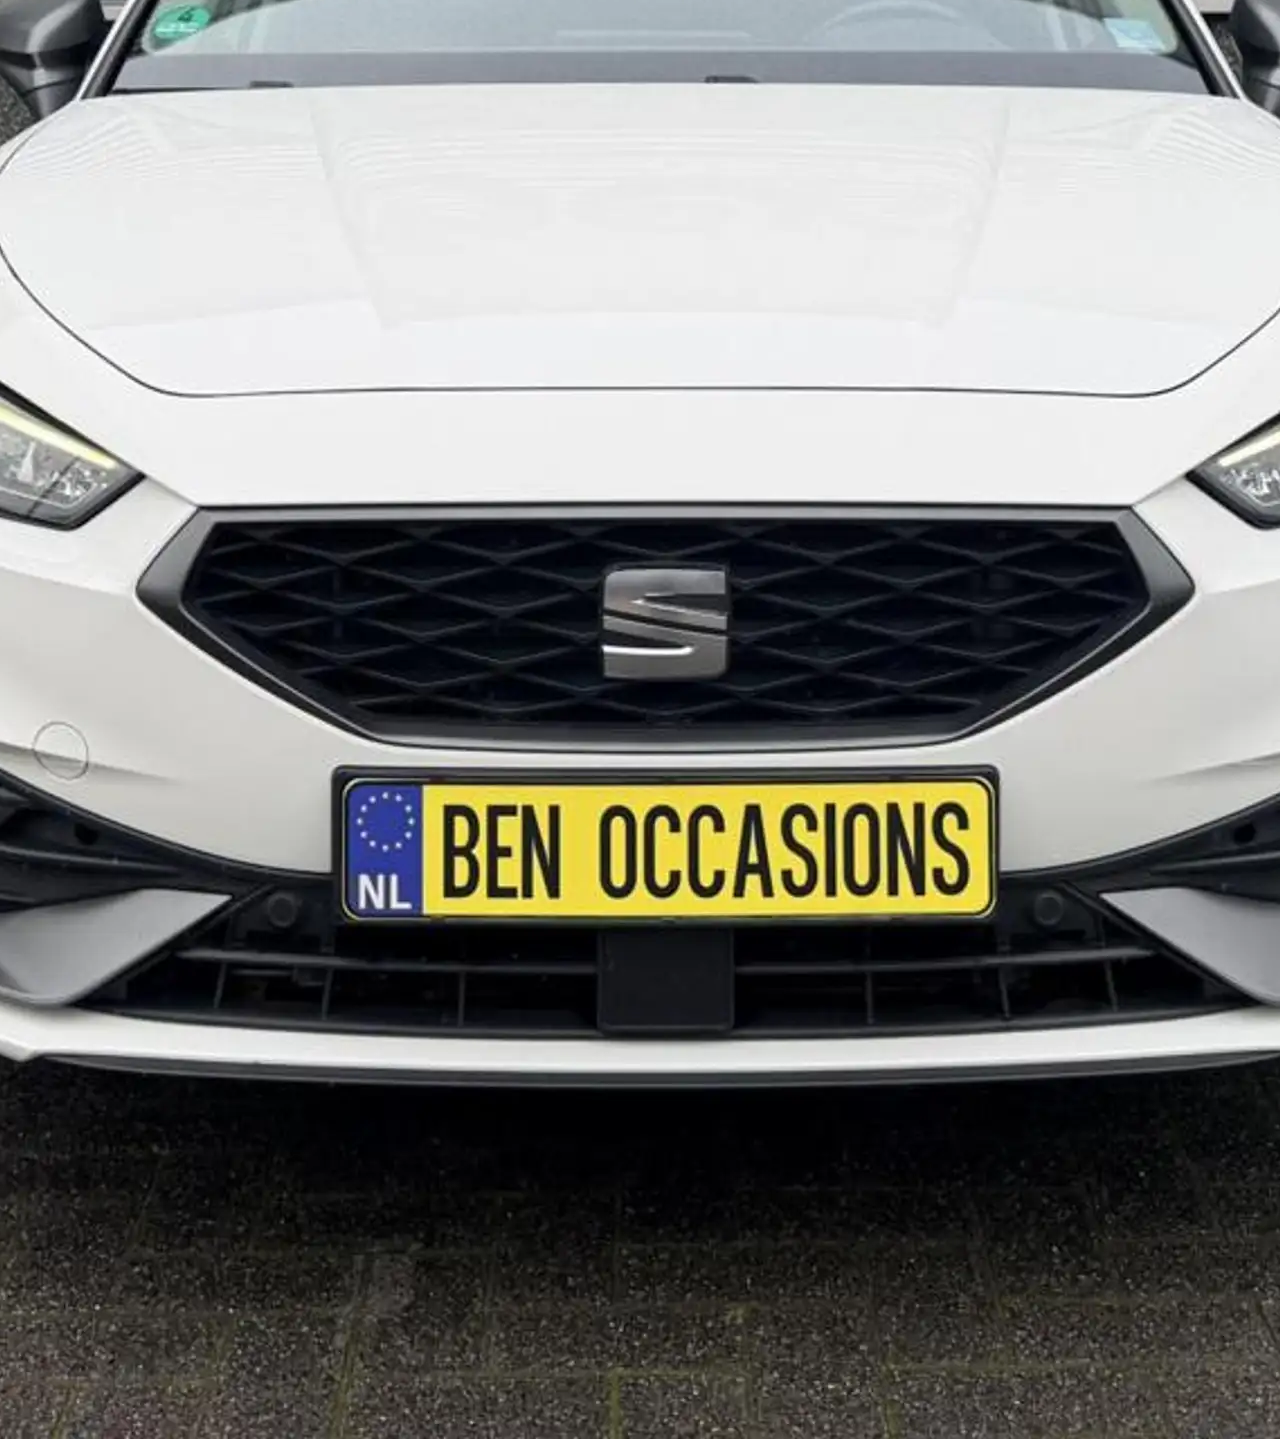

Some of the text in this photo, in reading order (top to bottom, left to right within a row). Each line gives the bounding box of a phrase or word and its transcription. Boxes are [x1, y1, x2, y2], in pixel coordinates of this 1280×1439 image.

[441, 802, 970, 900] BEN OCCASIONS
[357, 872, 412, 911] NL
